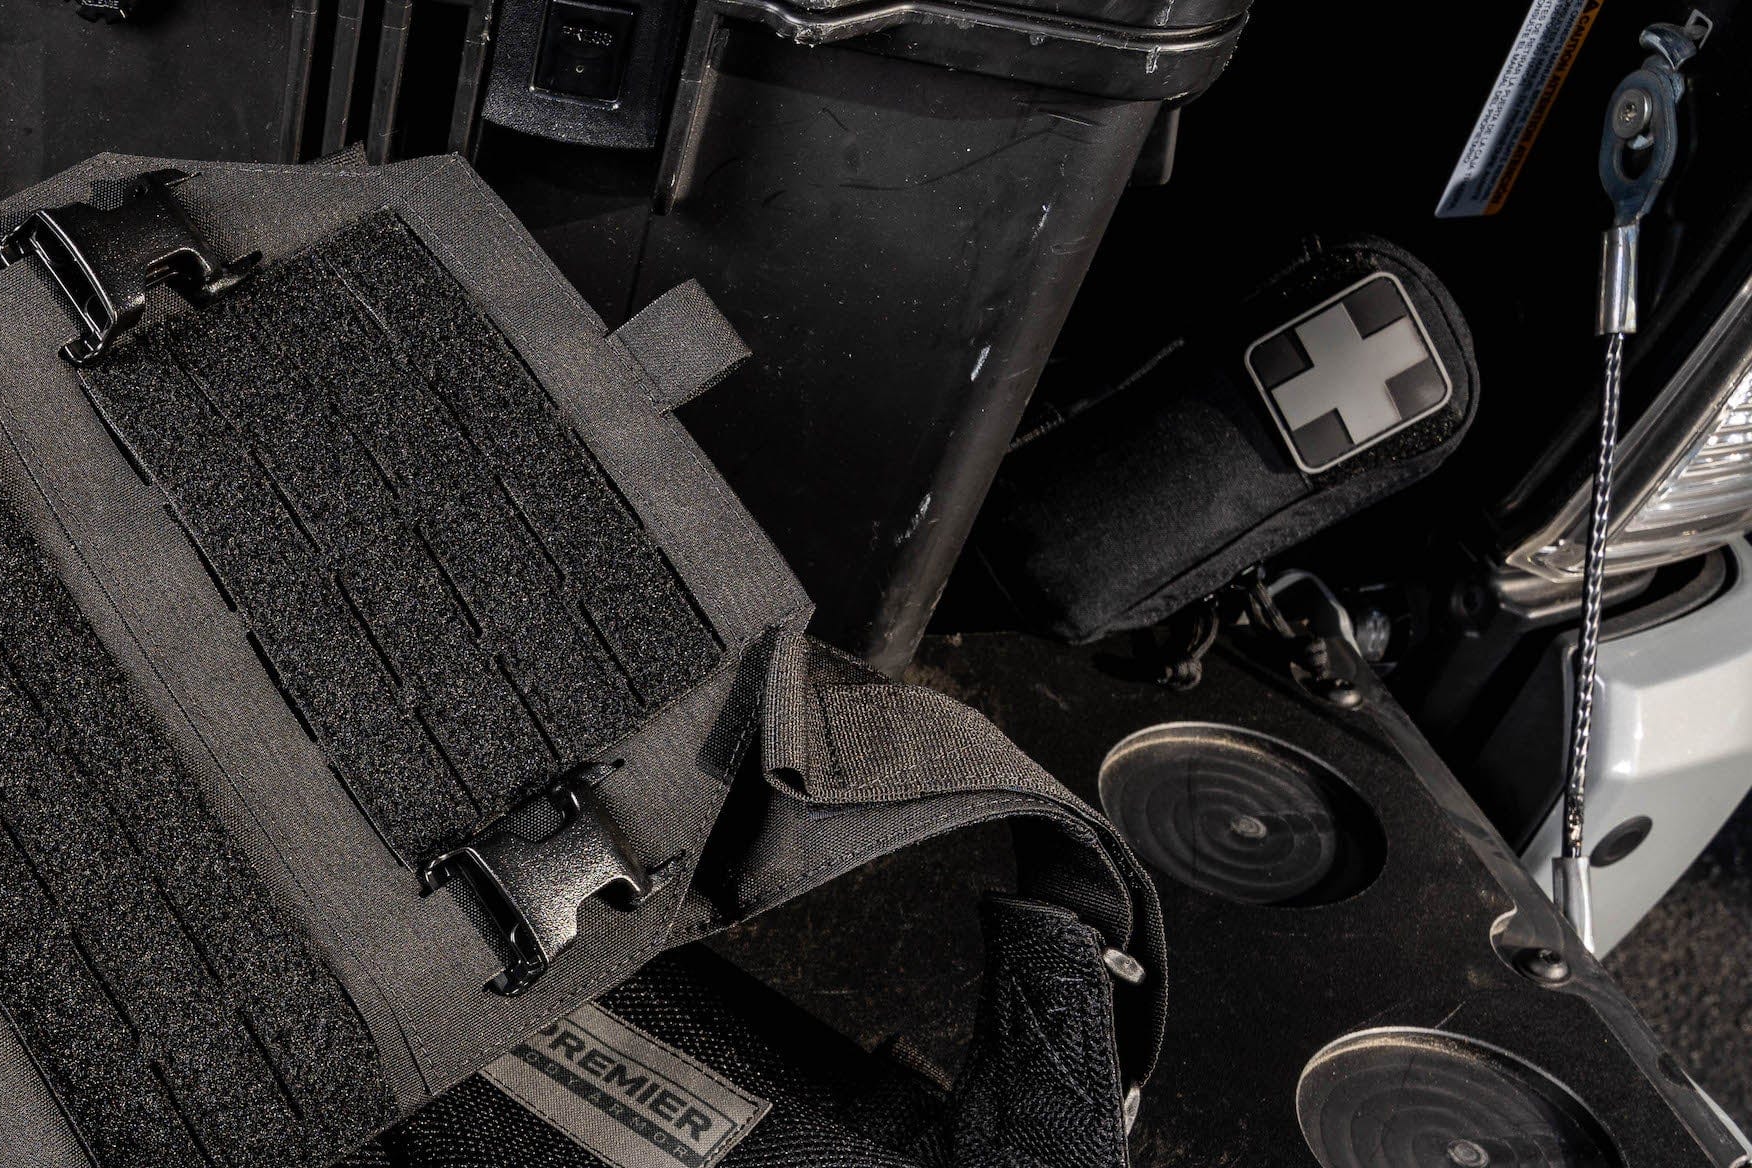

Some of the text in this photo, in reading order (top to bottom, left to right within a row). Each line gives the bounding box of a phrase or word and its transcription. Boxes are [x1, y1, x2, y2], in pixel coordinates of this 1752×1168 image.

[1554, 15, 1592, 71] CAUTION
[1497, 53, 1520, 88] MANUAL
[524, 1050, 581, 1090] ODY
